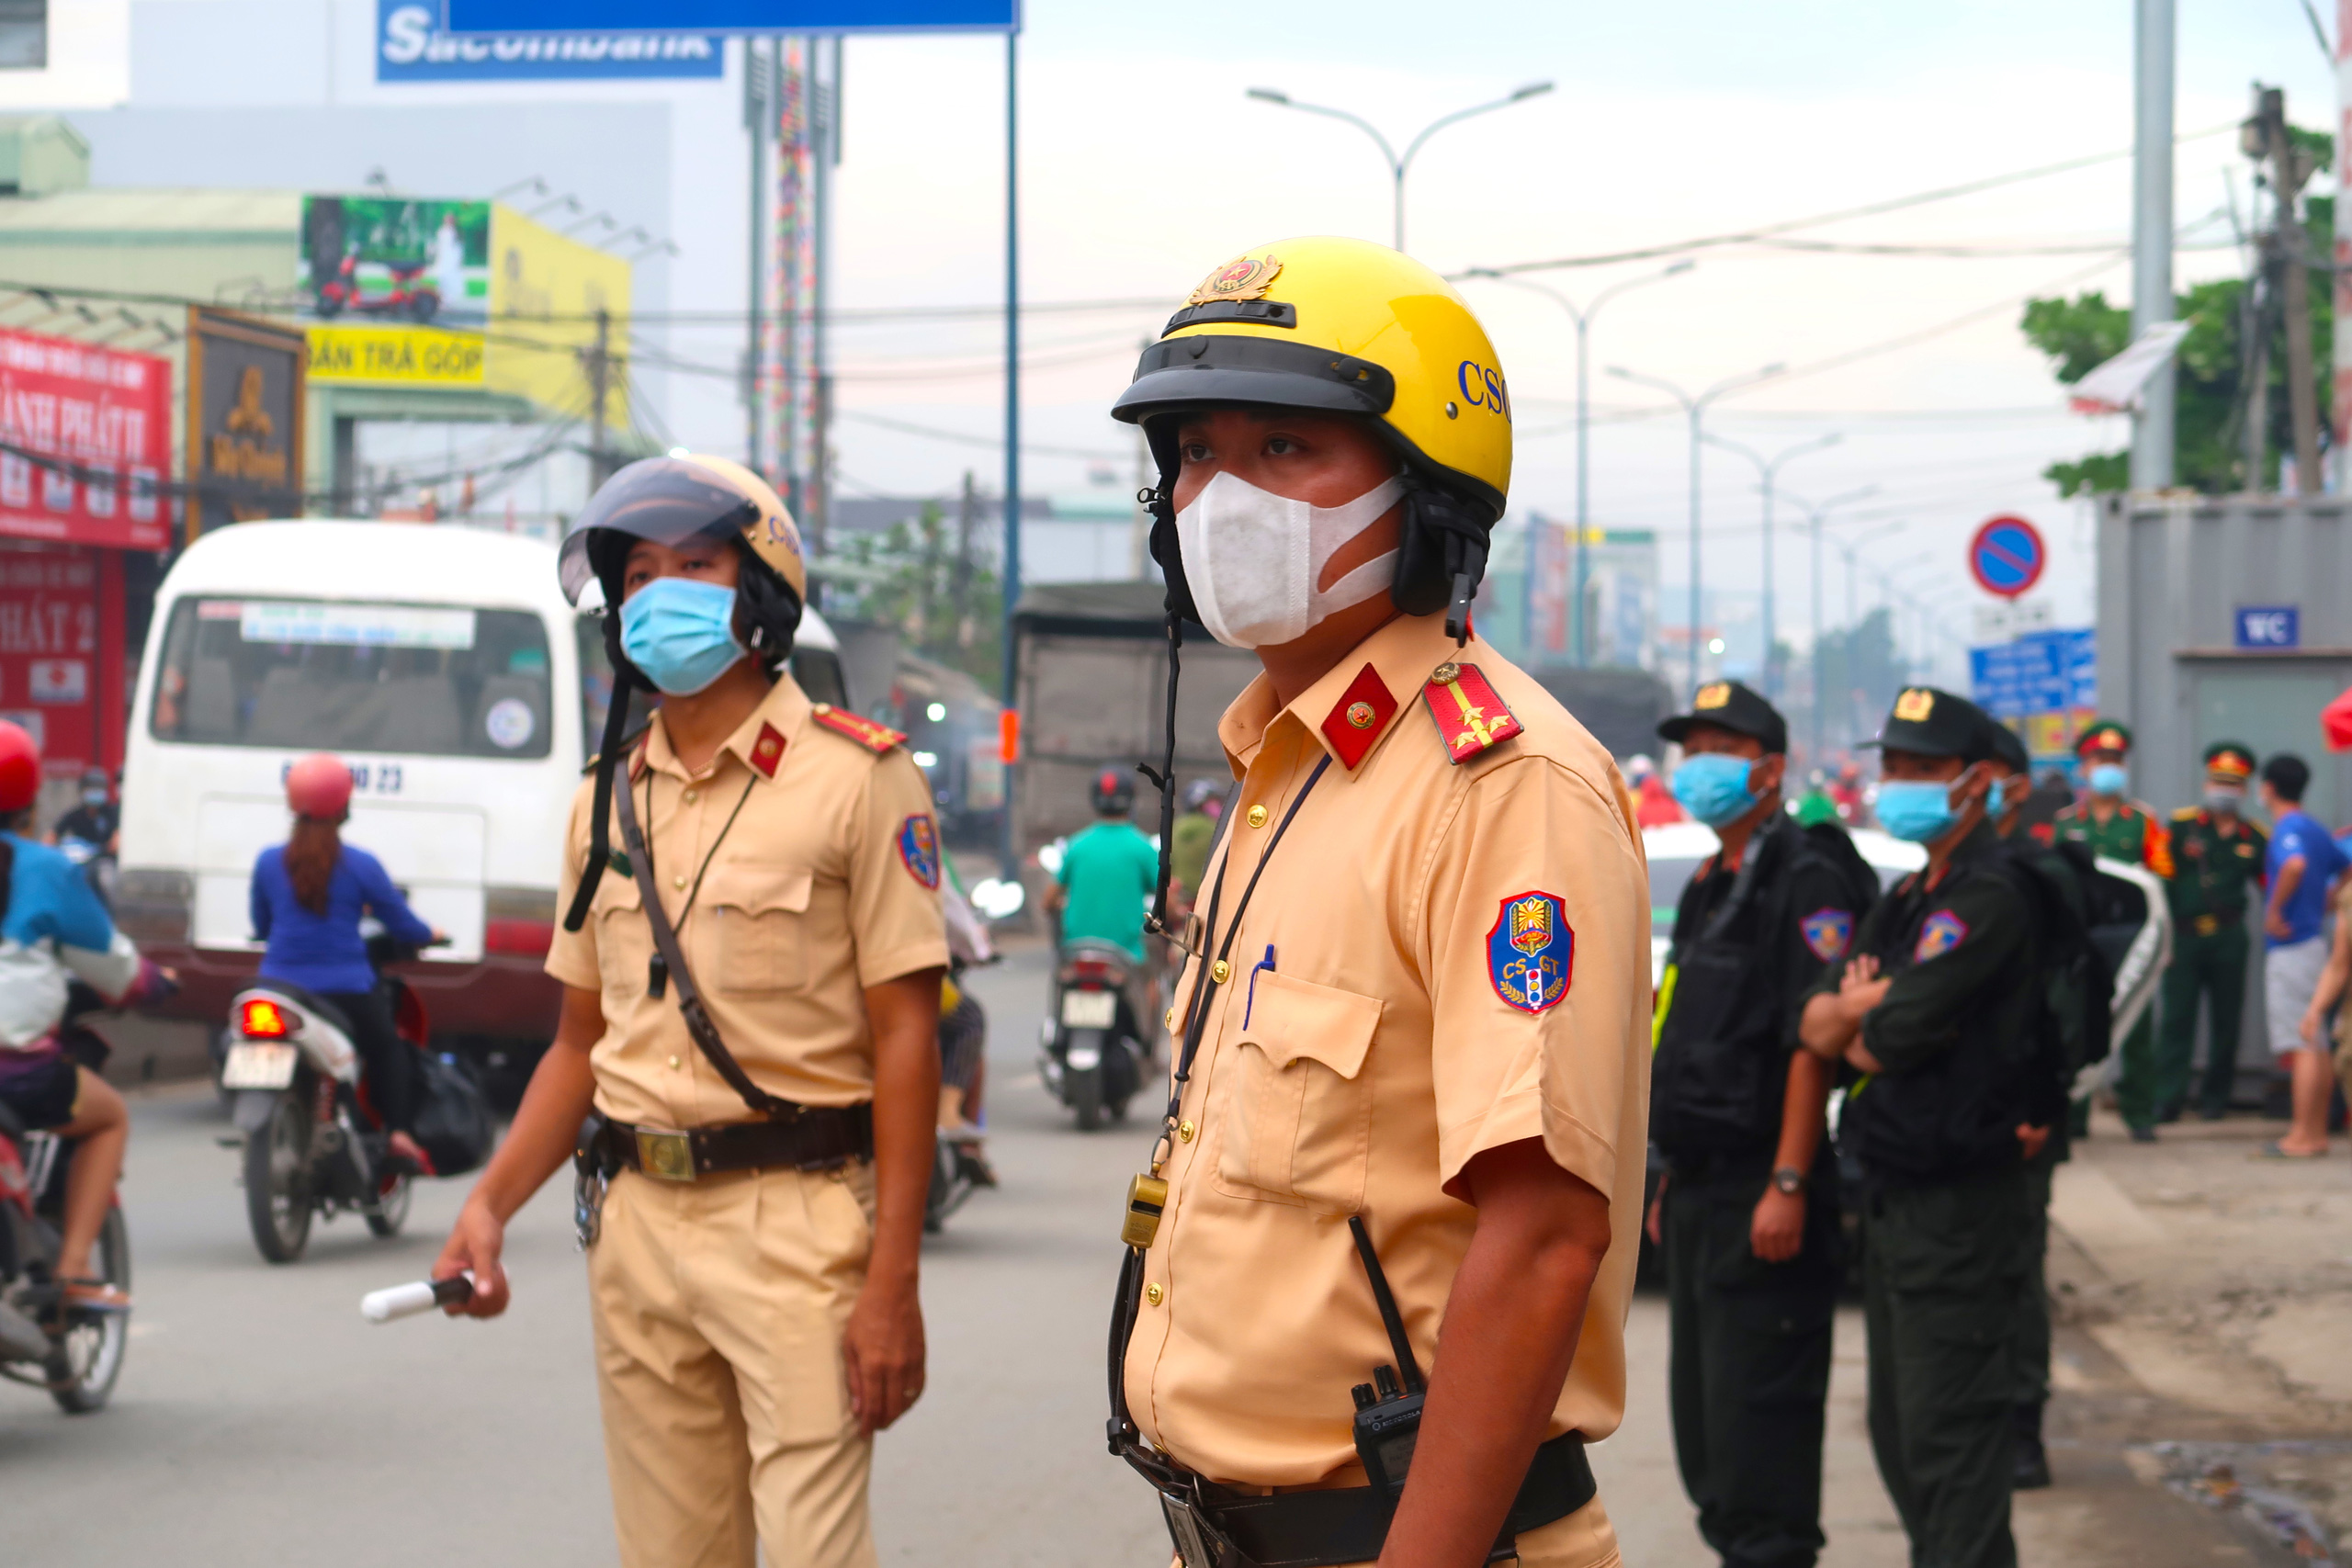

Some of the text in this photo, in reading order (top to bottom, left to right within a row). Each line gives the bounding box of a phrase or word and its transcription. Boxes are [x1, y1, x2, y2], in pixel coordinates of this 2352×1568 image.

[2245, 612, 2288, 644] WC
[1502, 955, 1560, 980] CS GT
[1382, 1410, 1420, 1427] MOTOROLA
